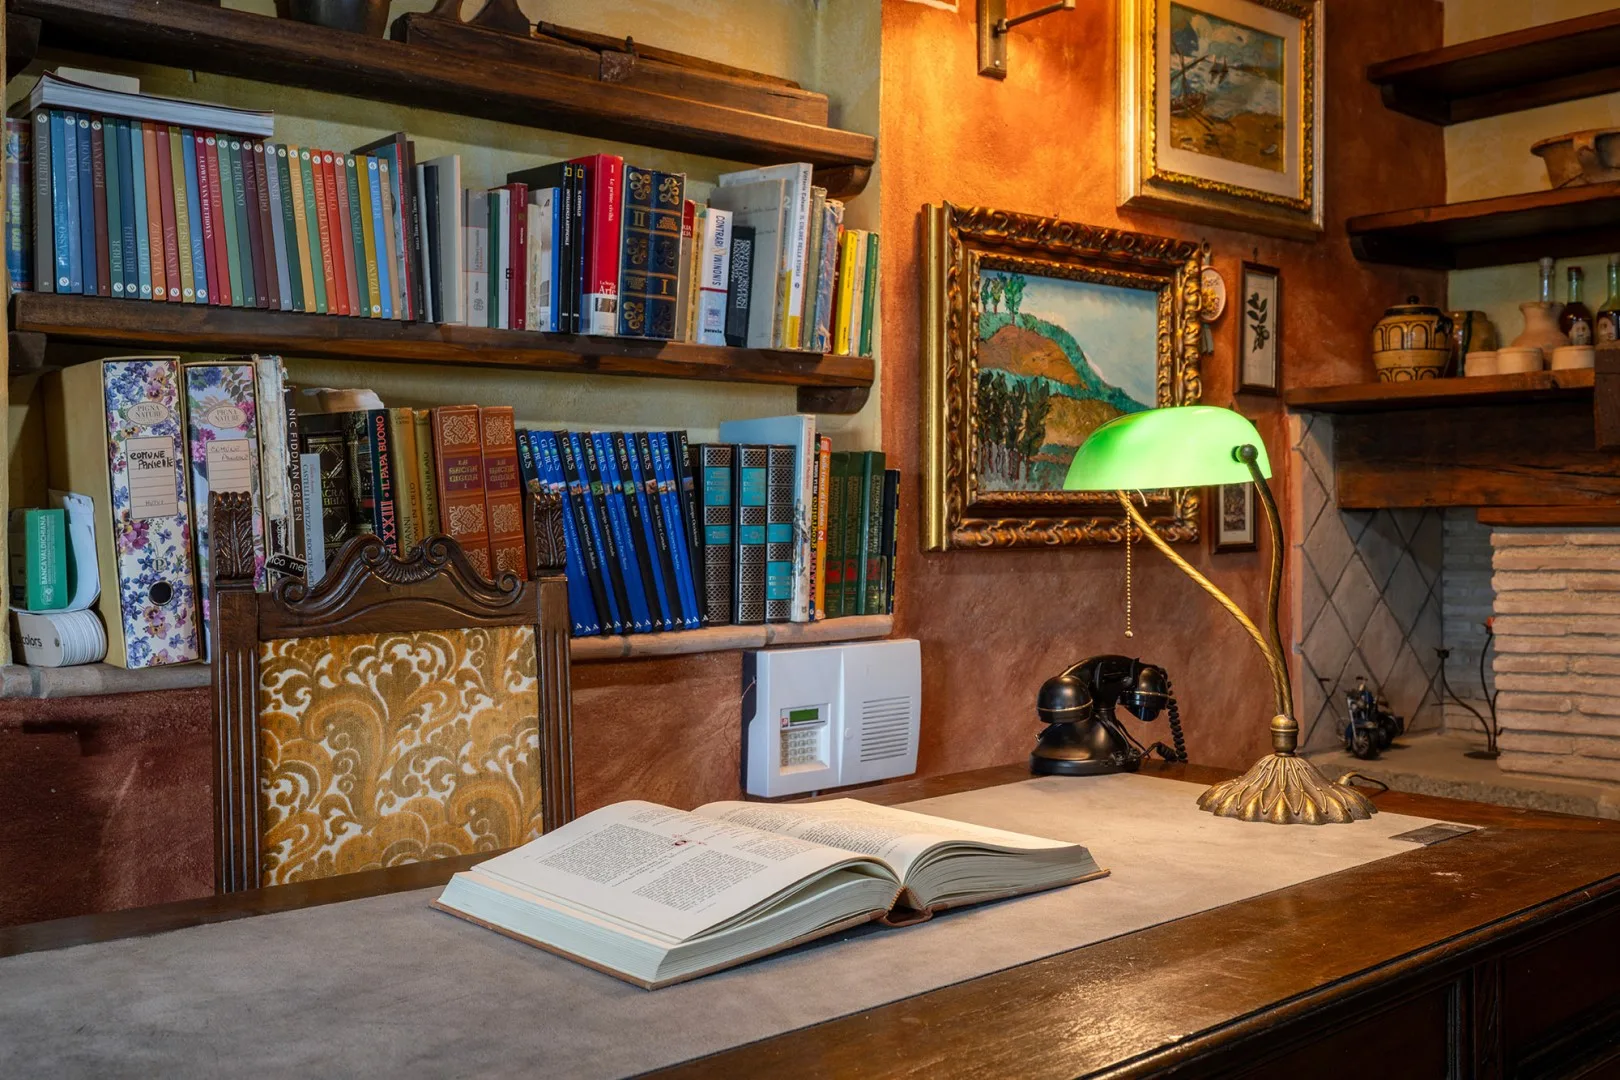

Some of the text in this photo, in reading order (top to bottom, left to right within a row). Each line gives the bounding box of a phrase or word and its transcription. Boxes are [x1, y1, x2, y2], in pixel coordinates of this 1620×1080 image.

[39, 135, 49, 196] TINTORETTO
[81, 141, 91, 173] MONET
[246, 161, 256, 191] MANET
[208, 156, 221, 208] RAFFAELLO
[234, 161, 245, 206] PERUGINO
[257, 164, 269, 211] LEONARDO
[281, 168, 293, 221] CARAVAGGIO
[327, 174, 337, 210] TIEPOLO
[371, 180, 381, 219] VERMEER
[203, 199, 212, 239] BEETHOVEN
[315, 174, 333, 282] PIERO DELLA FRANCESCA
[714, 215, 726, 248] CONTRARI
[166, 226, 177, 277] MANTEGNA
[712, 254, 723, 286] SINONIMI
[368, 260, 379, 296] TIZIANO
[661, 279, 668, 295] I
[375, 415, 386, 453] BUONO
[289, 409, 302, 521] NIC FIDDIAN GREEN
[379, 455, 389, 479] PAPA
[381, 480, 391, 490] IL
[381, 500, 396, 541] XXIII
[818, 530, 824, 541] 2
